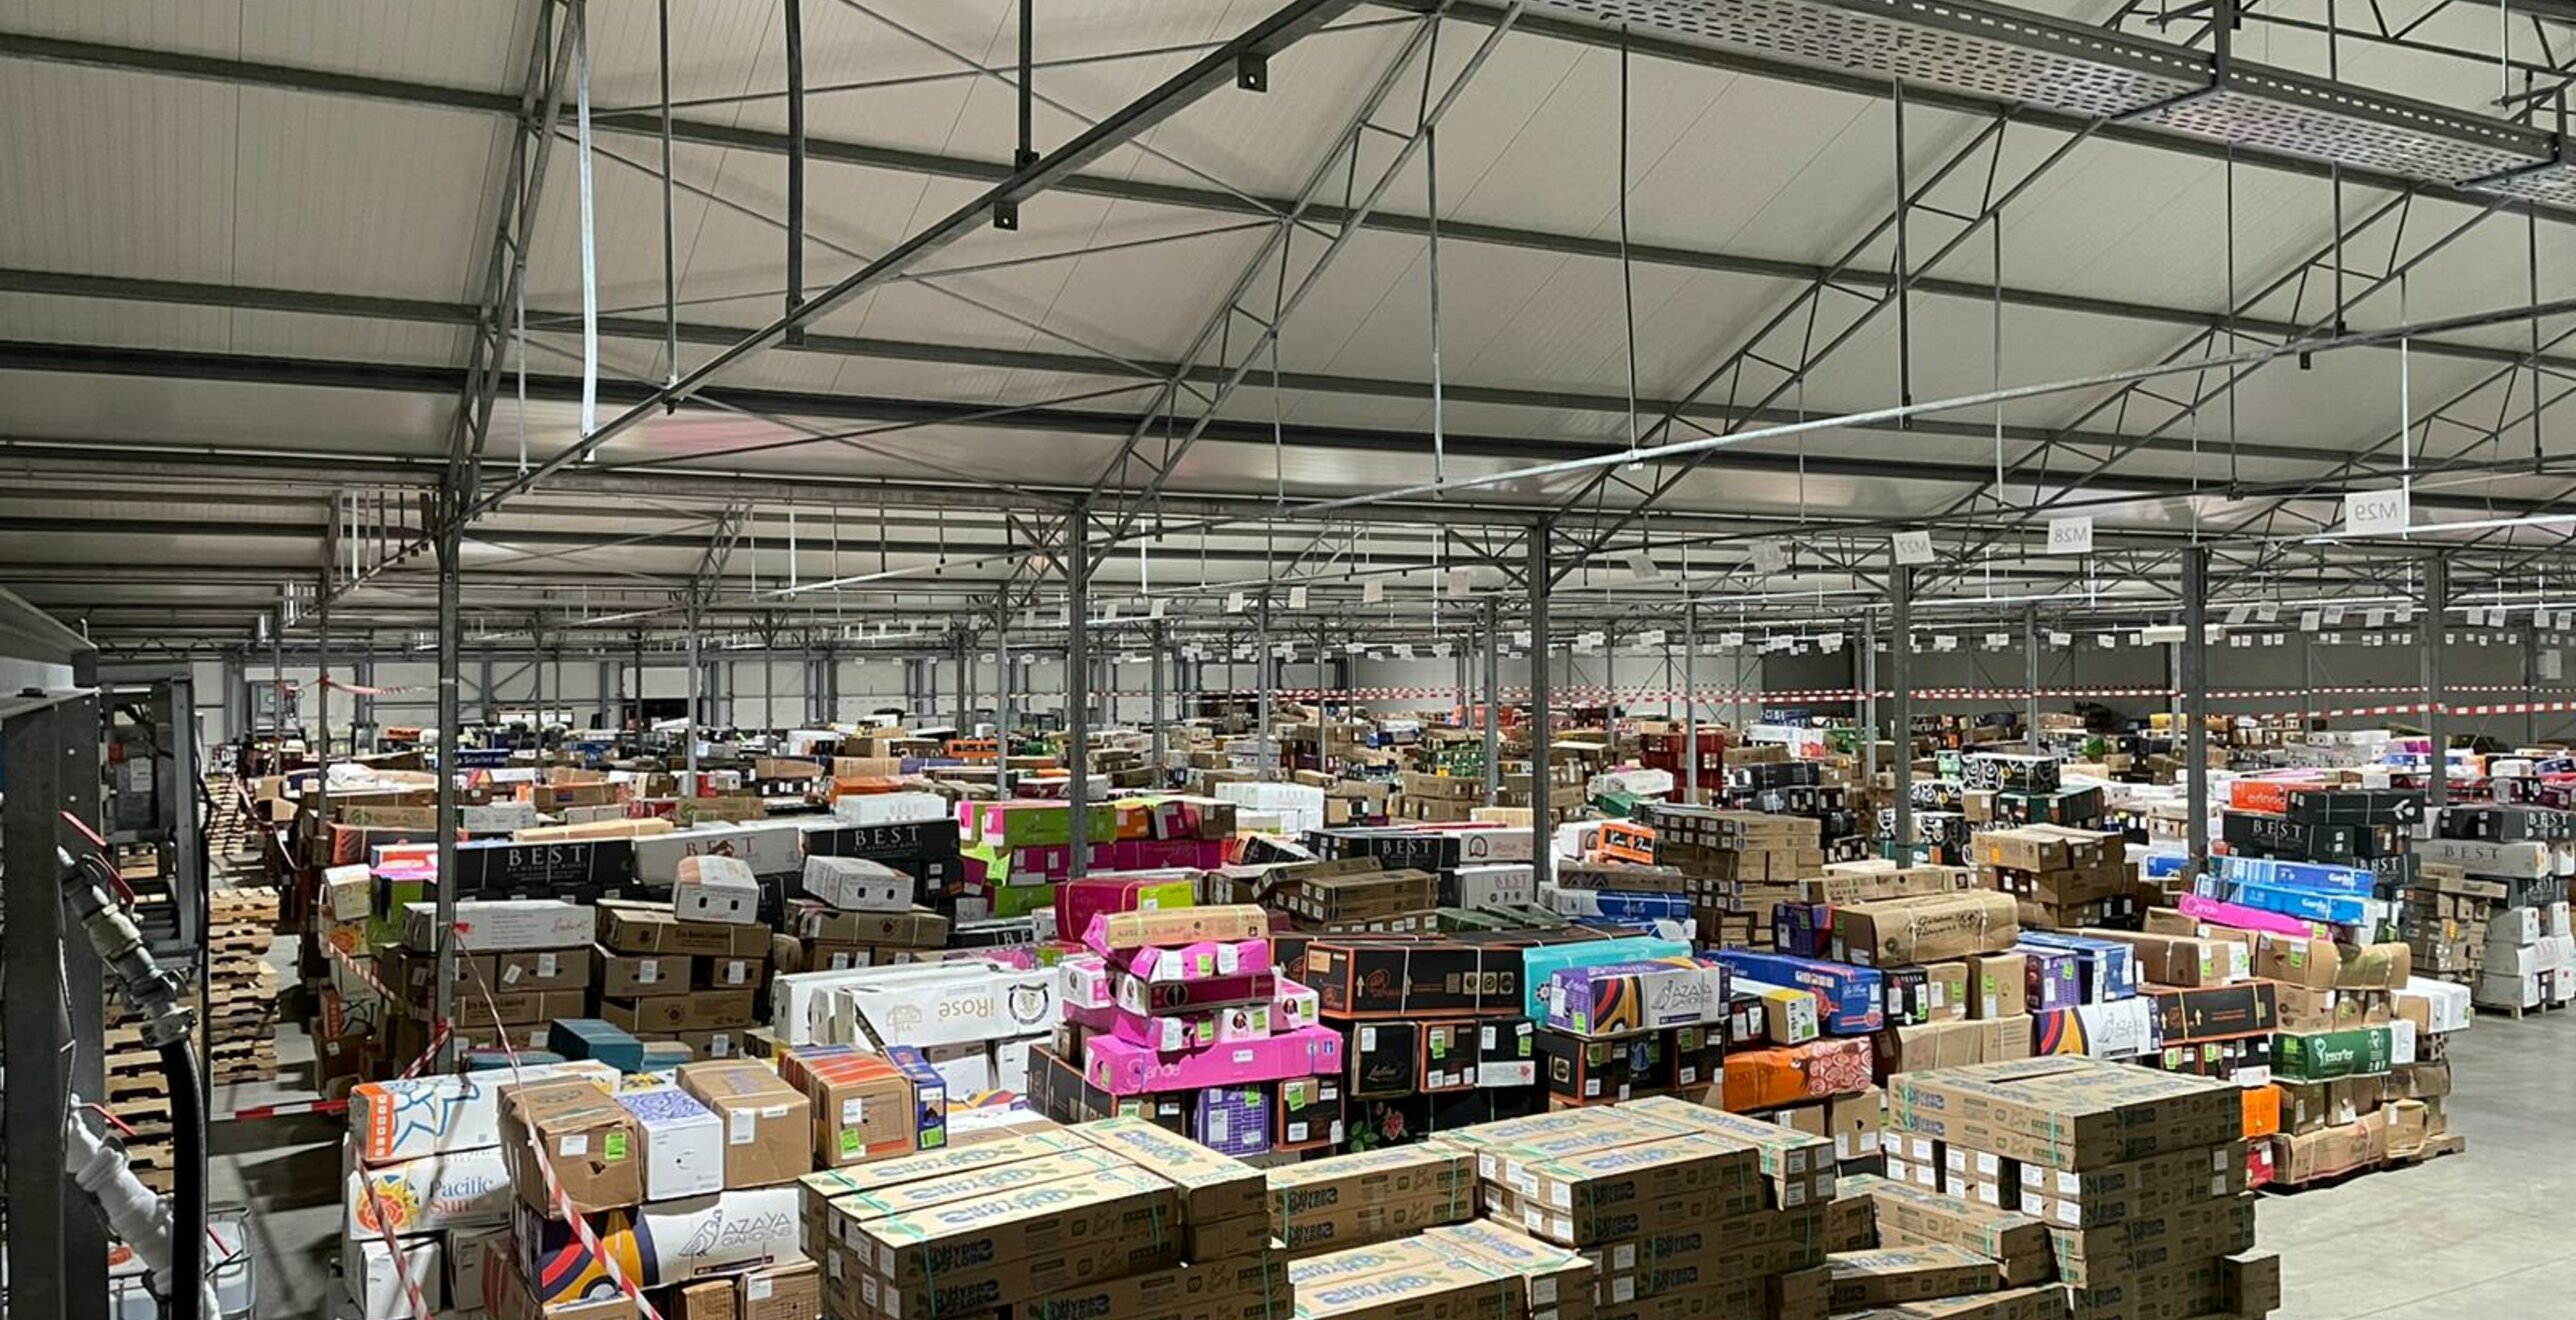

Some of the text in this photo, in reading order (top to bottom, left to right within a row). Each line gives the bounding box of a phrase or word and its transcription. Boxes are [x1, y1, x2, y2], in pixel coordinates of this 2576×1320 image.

[2253, 819, 2303, 838] BEST
[2529, 812, 2569, 826] BEST
[855, 826, 920, 846] BEST
[509, 845, 587, 867] BEST
[1382, 840, 1432, 854] BEST
[2444, 847, 2499, 860] BEST
[938, 997, 995, 1018] iRose
[430, 1175, 494, 1199] Pacific
[430, 1198, 470, 1215] Sun
[721, 1211, 792, 1238] AZAYA
